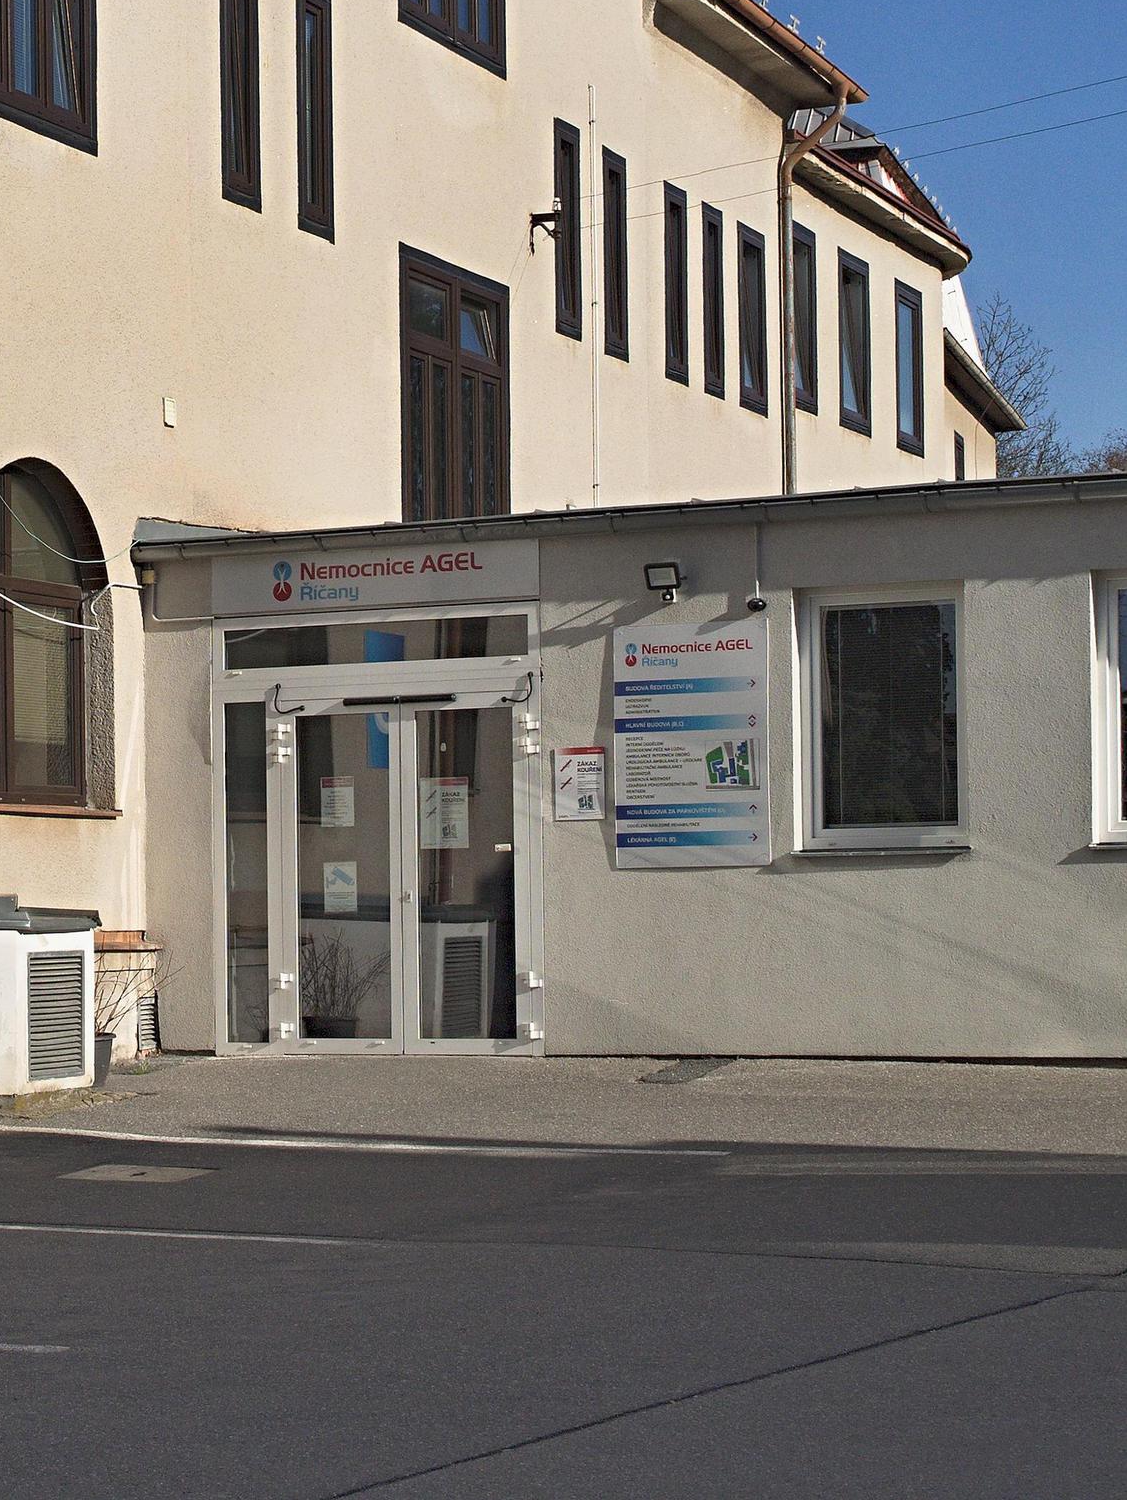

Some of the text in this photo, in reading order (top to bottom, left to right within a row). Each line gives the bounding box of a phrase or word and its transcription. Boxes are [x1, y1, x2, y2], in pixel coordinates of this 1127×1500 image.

[300, 552, 483, 580] Nemocnice AGEL
[300, 583, 359, 601] Říčany
[641, 639, 753, 654] Nemocnice AGEL
[642, 656, 678, 667] Říčany
